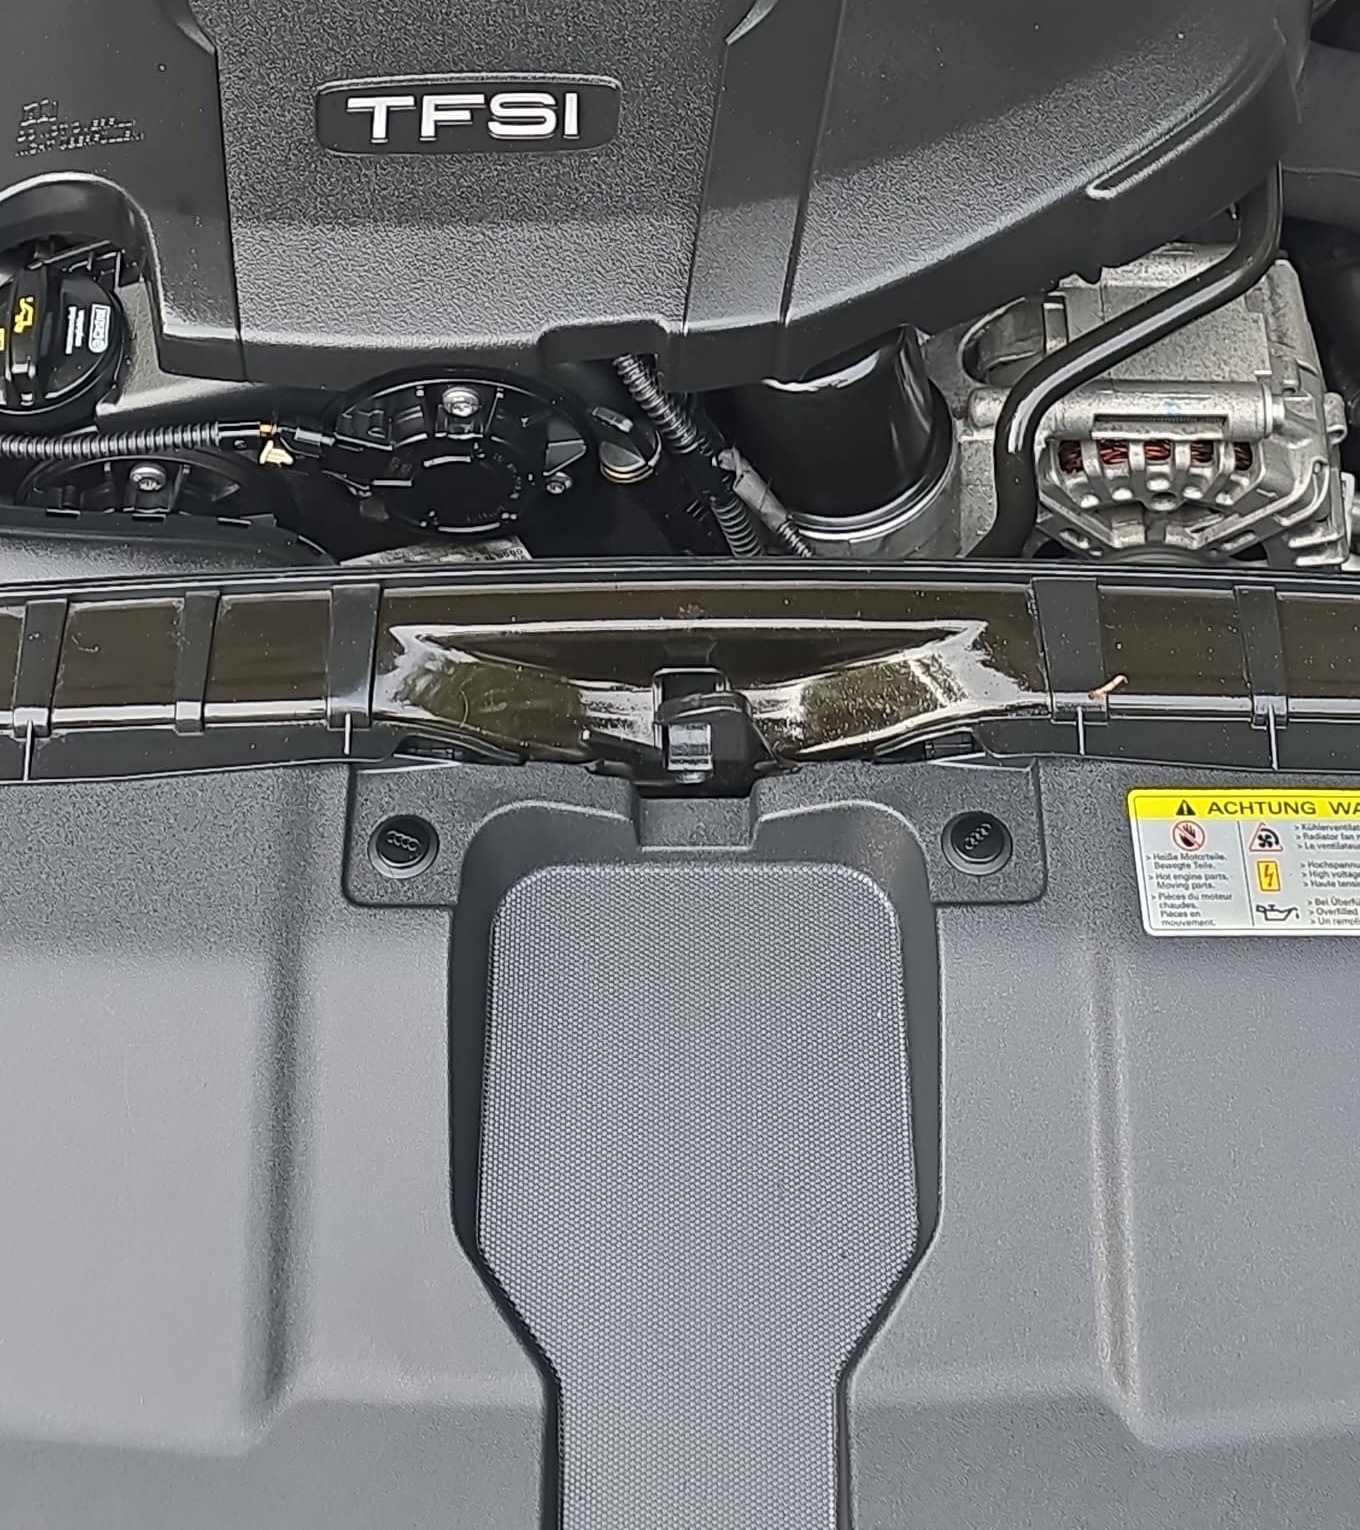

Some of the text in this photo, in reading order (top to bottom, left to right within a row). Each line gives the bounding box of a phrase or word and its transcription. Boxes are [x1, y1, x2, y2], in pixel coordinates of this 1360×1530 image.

[346, 92, 580, 142] TFSI
[1207, 801, 1316, 815] ACHTUNG
[1173, 873, 1202, 881] engine
[1156, 882, 1190, 890] Moving
[1188, 892, 1199, 900] du
[1201, 892, 1232, 900] moteur
[1317, 917, 1331, 925] Un
